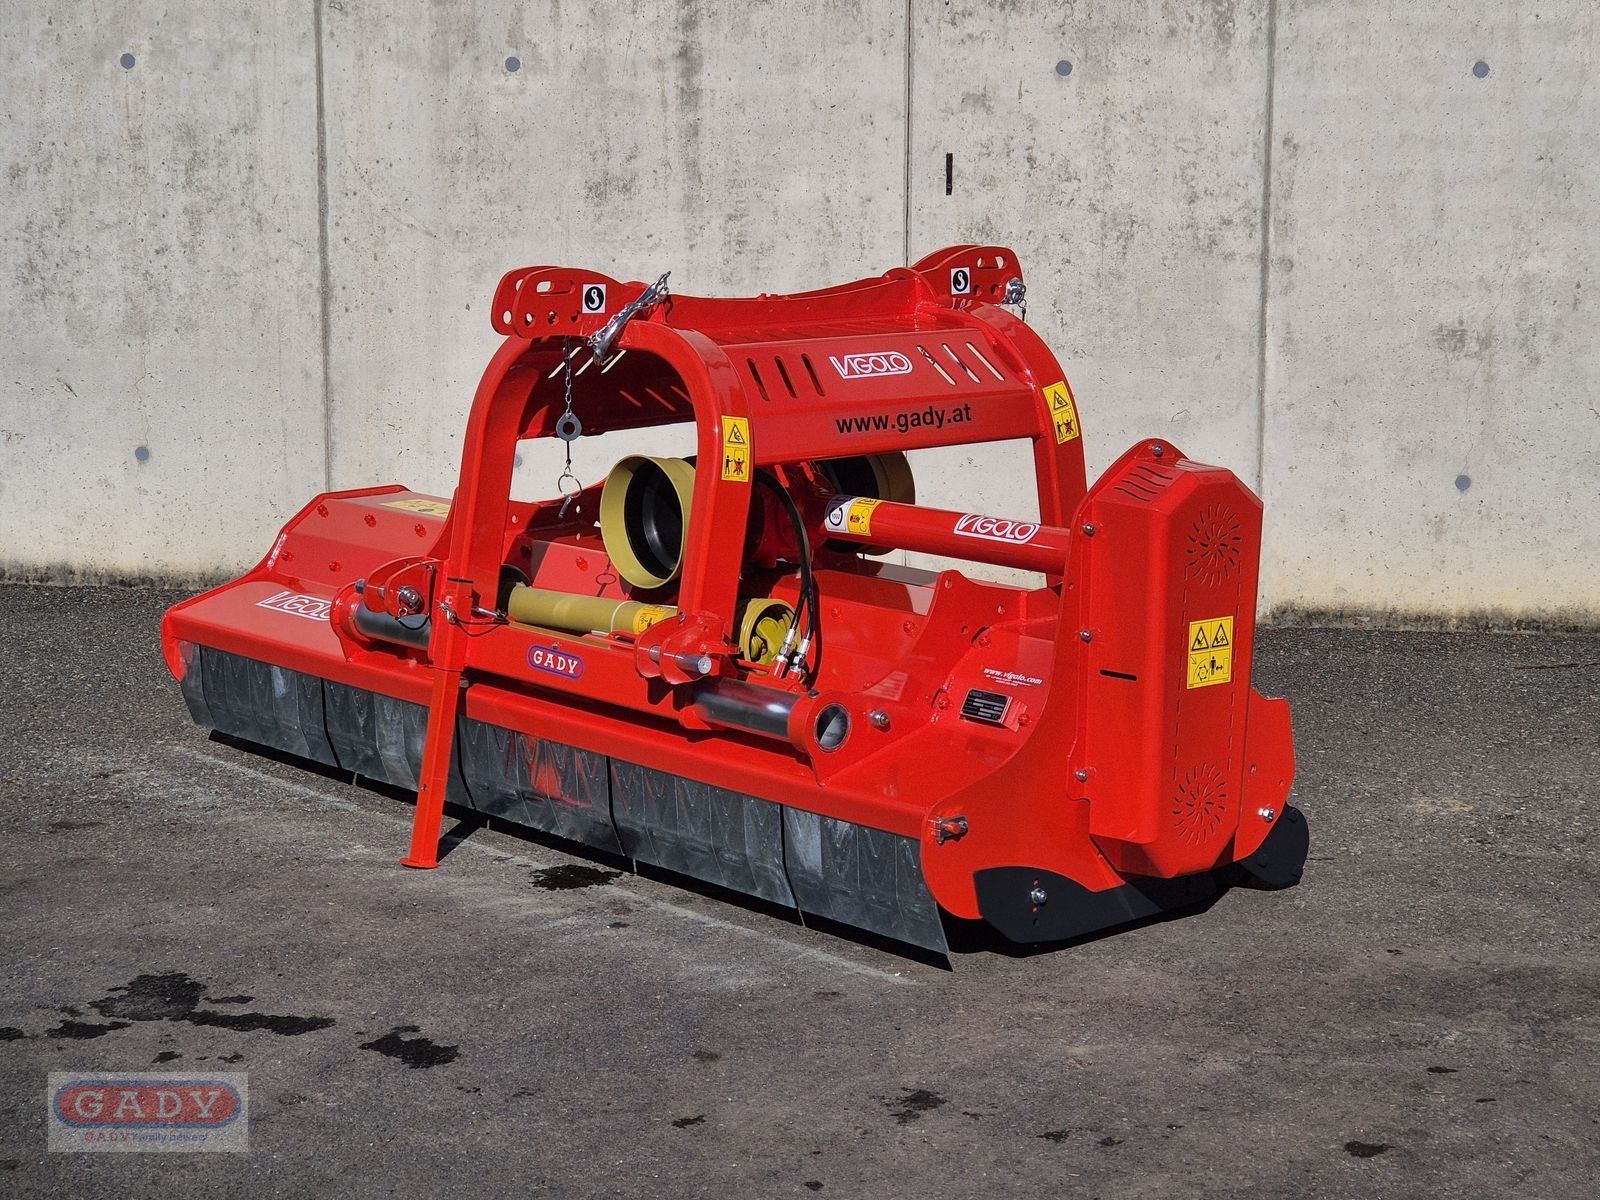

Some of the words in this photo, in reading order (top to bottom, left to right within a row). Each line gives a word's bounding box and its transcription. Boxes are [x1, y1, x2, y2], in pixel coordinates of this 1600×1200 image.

[829, 351, 913, 379] VIGOLO
[835, 403, 972, 434] www.gady.at
[953, 513, 1040, 544] VIGOLO
[533, 650, 578, 674] GADY
[983, 668, 1043, 685] www.vigolo.com
